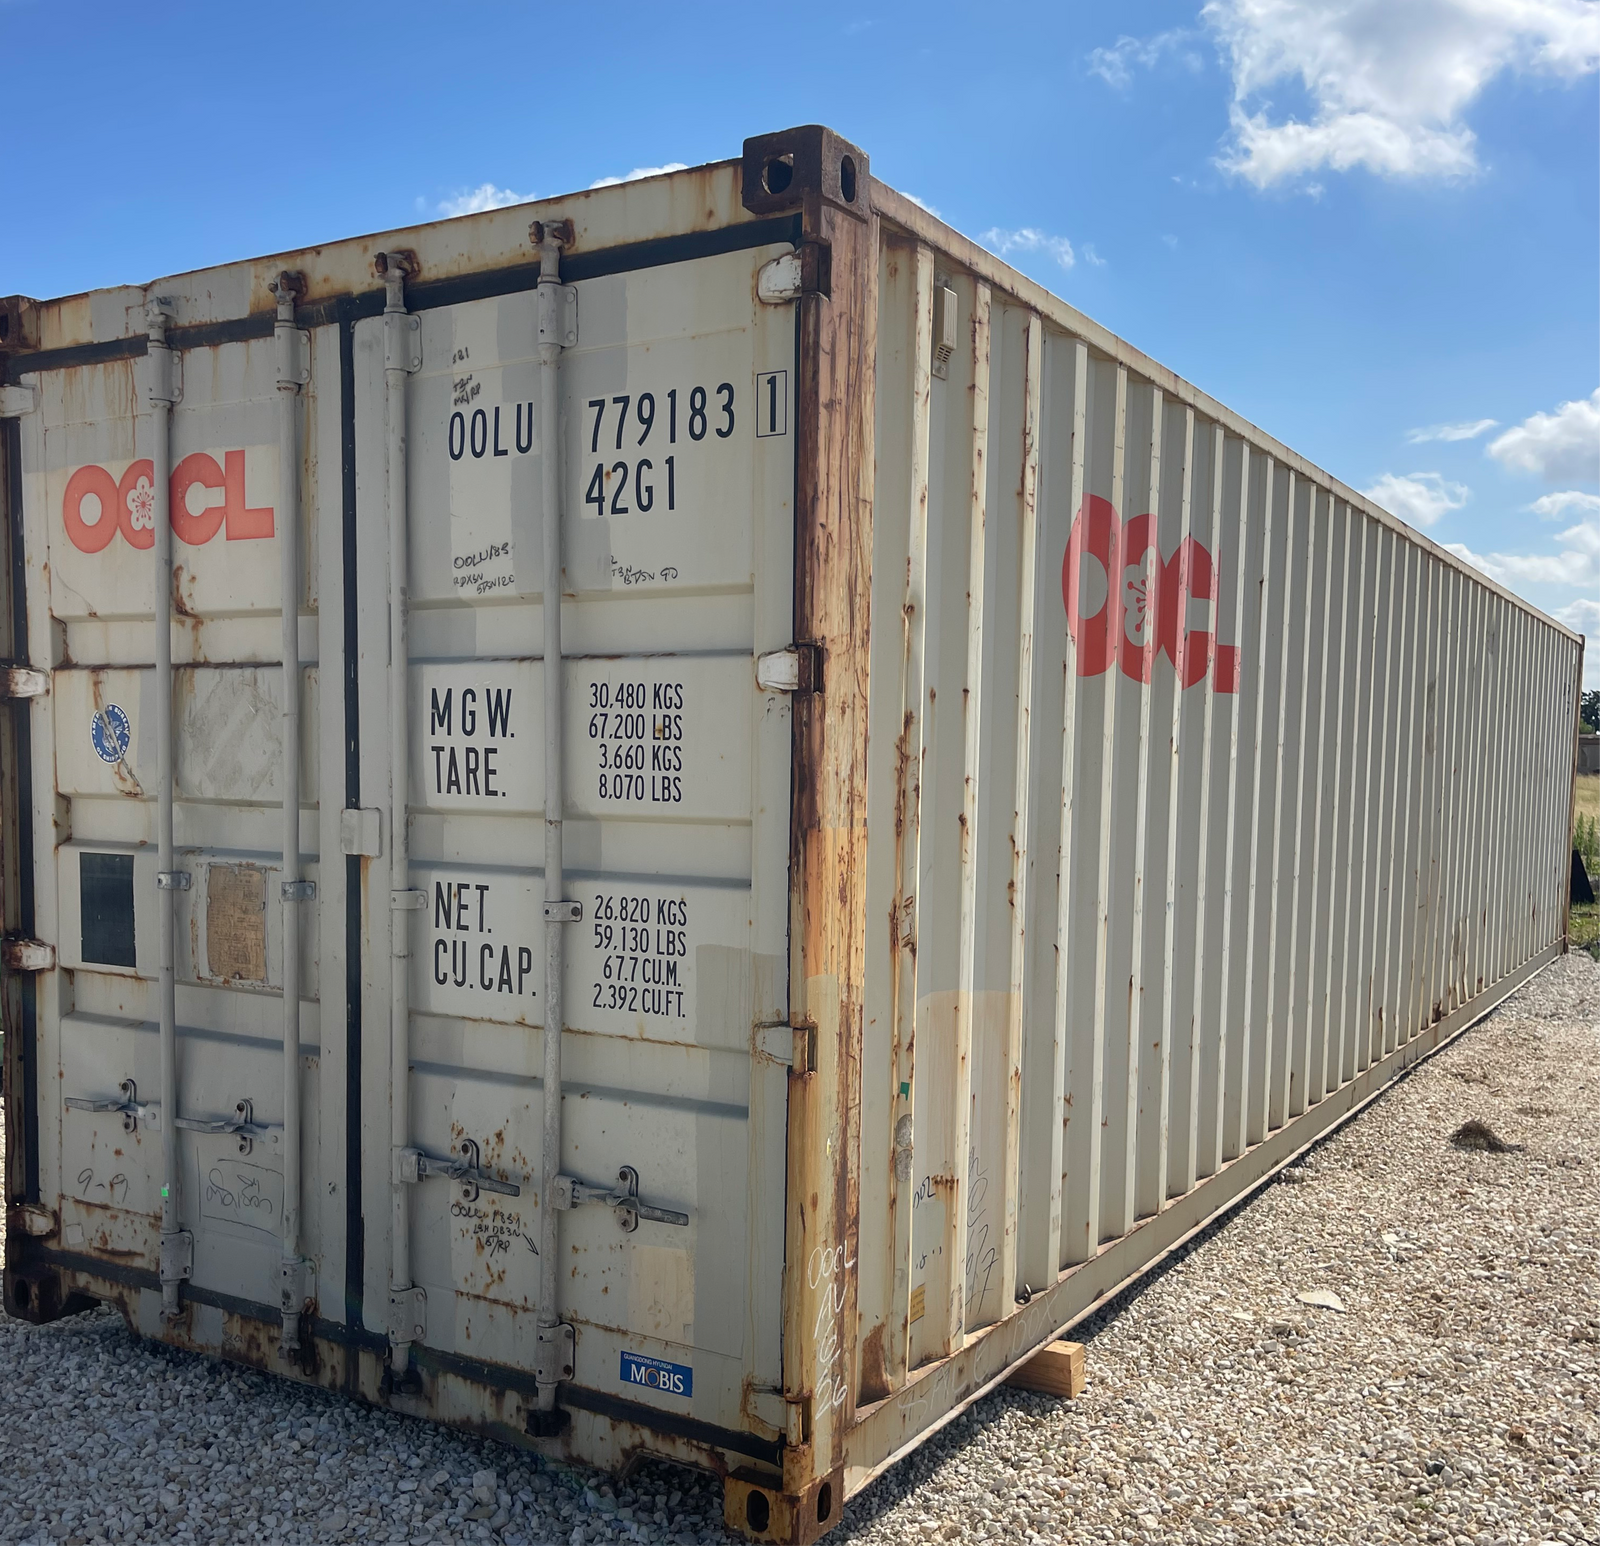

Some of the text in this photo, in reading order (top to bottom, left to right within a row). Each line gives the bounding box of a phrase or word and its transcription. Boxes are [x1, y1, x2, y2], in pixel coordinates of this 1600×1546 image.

[449, 401, 533, 461] OOLU
[588, 382, 735, 453] 779183
[585, 455, 674, 516] 42G1
[589, 682, 684, 711] 30,480 KGS
[588, 712, 683, 742] 67,200 LBS
[430, 746, 506, 797] TARE.
[598, 743, 683, 772] 3,660 KGS
[598, 773, 682, 803] 8,070 LBS
[434, 881, 492, 934] NET.
[594, 894, 688, 927] 26,820 KGS
[594, 923, 687, 957] 59,130 LBS
[603, 955, 682, 988] 67.7 CU.M.
[592, 982, 687, 1019] 2,392 CU.FT.
[630, 1363, 684, 1393] MOBIS
[652, 1360, 673, 1370] HYUNDAI
